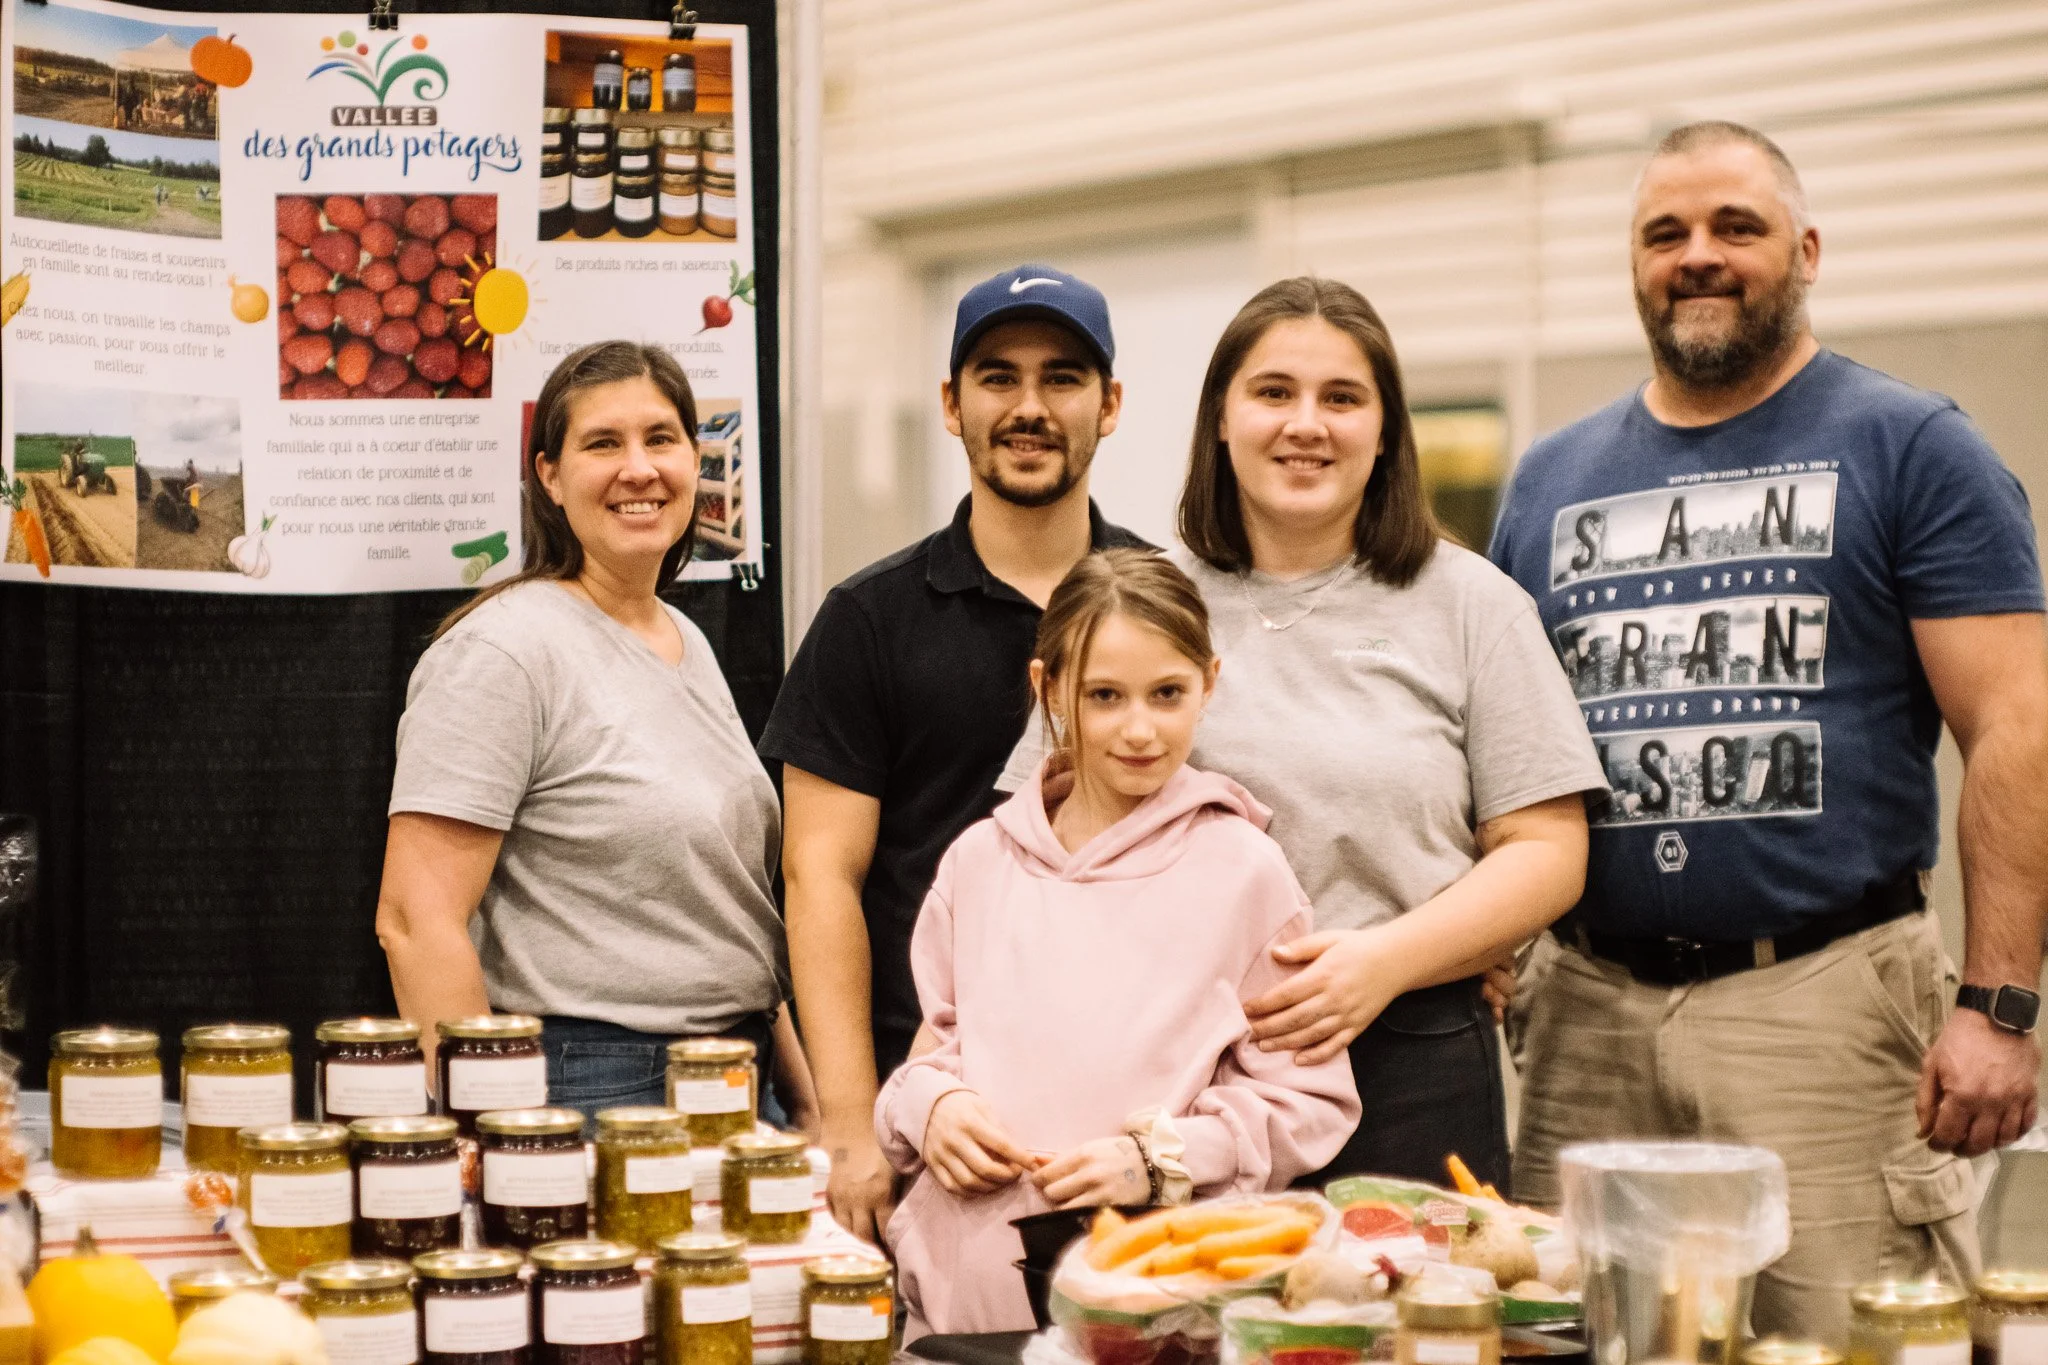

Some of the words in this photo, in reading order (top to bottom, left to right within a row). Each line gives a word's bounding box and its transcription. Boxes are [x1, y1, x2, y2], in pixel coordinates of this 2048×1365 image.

[243, 127, 288, 158] des
[296, 127, 396, 182] grands
[403, 127, 522, 182] potagers
[93, 244, 107, 258] de
[110, 246, 148, 263] fraises
[151, 251, 163, 264] et
[166, 253, 227, 269] souvenirs
[555, 257, 572, 271] Des
[576, 257, 621, 272] produits
[624, 257, 659, 271] riches
[663, 259, 677, 271] en
[22, 256, 36, 268] en
[41, 256, 81, 273] famille
[84, 264, 109, 278] sont
[113, 267, 128, 279] au
[82, 311, 98, 324] on
[104, 312, 155, 331] travaille
[159, 317, 176, 332] les
[180, 319, 231, 337] champs
[16, 327, 44, 343] avec
[104, 336, 134, 351] pour
[140, 340, 169, 355] vous
[173, 342, 208, 358] offrir
[213, 344, 225, 358] le
[539, 341, 561, 354] Une
[289, 413, 325, 427] Nous
[329, 413, 385, 427] sommes
[390, 414, 416, 426] une
[419, 413, 480, 428] entreprise
[266, 439, 325, 455] familiale
[329, 440, 352, 456] qui
[357, 441, 365, 453] a
[370, 438, 378, 453] à
[383, 440, 421, 453] coeur
[476, 439, 498, 451] une
[298, 466, 352, 481] relation
[357, 466, 375, 480] de
[379, 464, 441, 482] proximité
[444, 465, 454, 478] et
[458, 464, 473, 478] de
[270, 492, 337, 508] confiance
[340, 493, 372, 507] avec
[376, 493, 399, 506] nos
[449, 492, 468, 507] qui
[471, 491, 495, 504] sont
[282, 521, 313, 536] pour
[319, 520, 354, 535] nous
[359, 521, 385, 534] une
[388, 518, 441, 533] véritable
[444, 517, 486, 533] grande
[1571, 485, 1797, 571] SAN
[1643, 580, 1675, 598] OR
[1701, 567, 1796, 592] NEVER
[1712, 697, 1800, 715] BRAND
